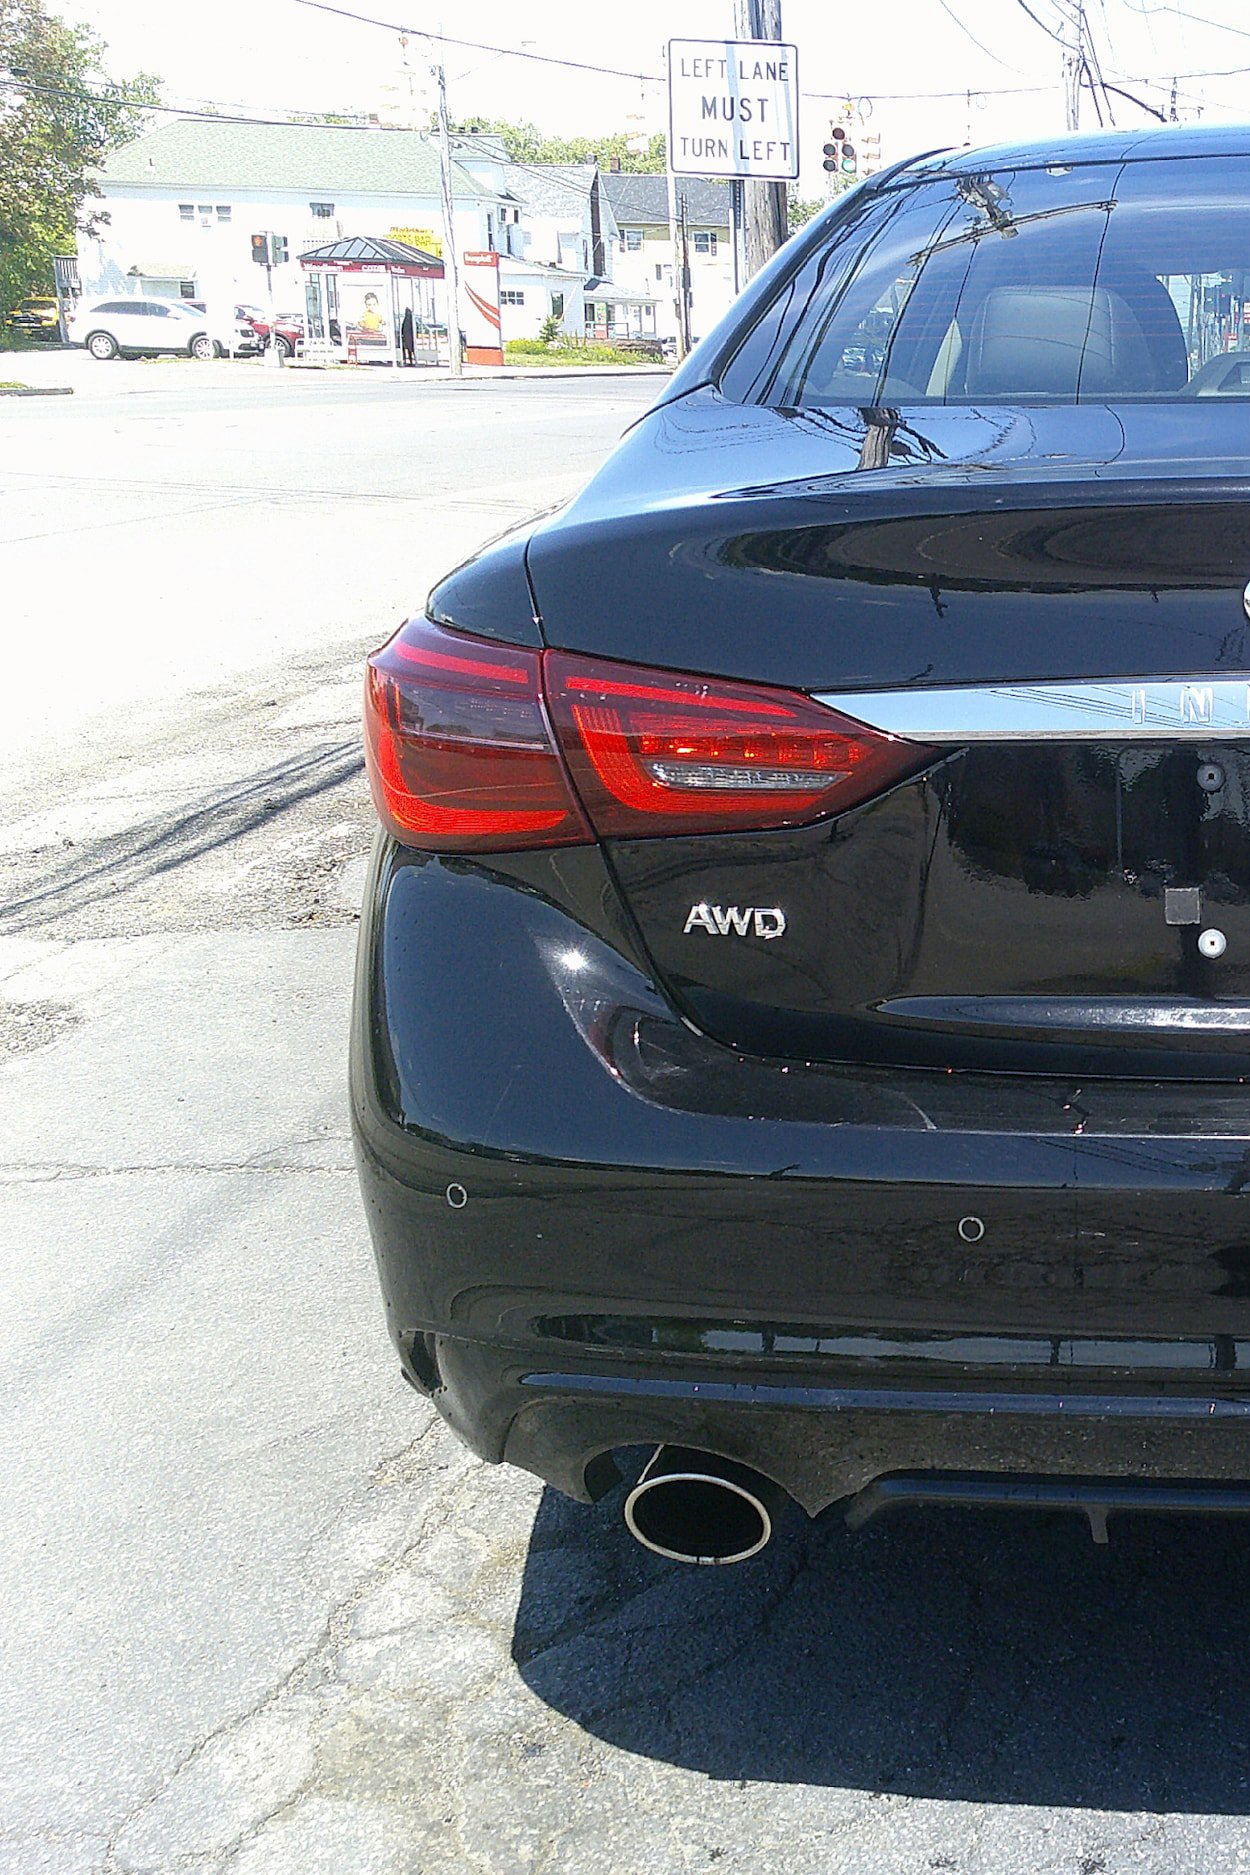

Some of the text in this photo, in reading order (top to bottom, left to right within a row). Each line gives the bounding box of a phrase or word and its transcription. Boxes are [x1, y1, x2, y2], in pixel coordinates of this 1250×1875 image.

[681, 58, 789, 82] LEFT LANE
[701, 95, 769, 123] MUST
[680, 136, 791, 161] TURN LEFT
[683, 902, 787, 940] AWD
